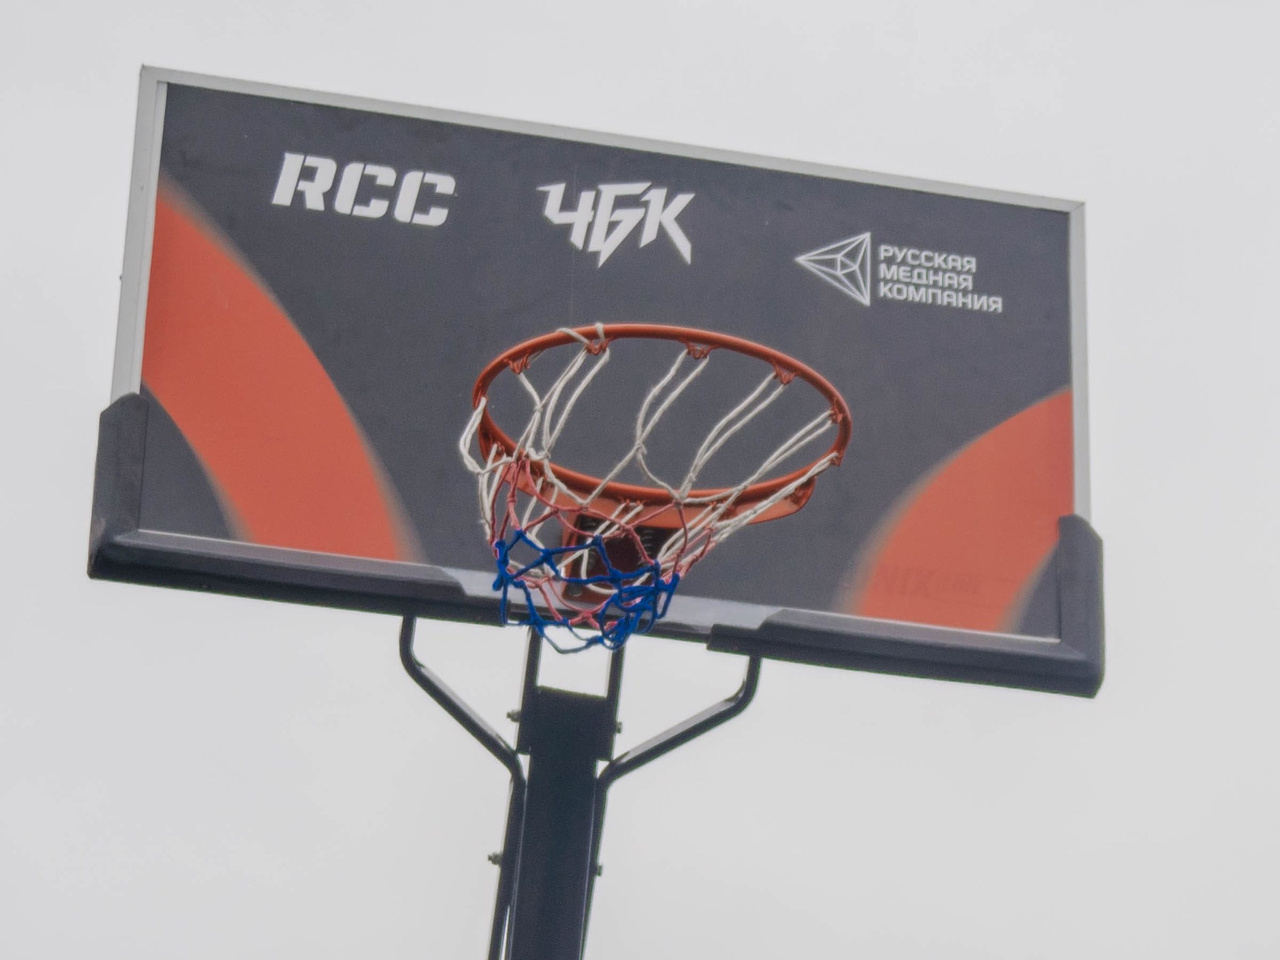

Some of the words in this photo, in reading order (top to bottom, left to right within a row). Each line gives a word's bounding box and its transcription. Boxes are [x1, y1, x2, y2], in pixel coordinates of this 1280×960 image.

[271, 152, 456, 227] RCC
[879, 244, 976, 273] РУССКАЯ
[879, 263, 973, 291] МЕДНАЯ
[879, 281, 1003, 313] КОМПАНИЯ
